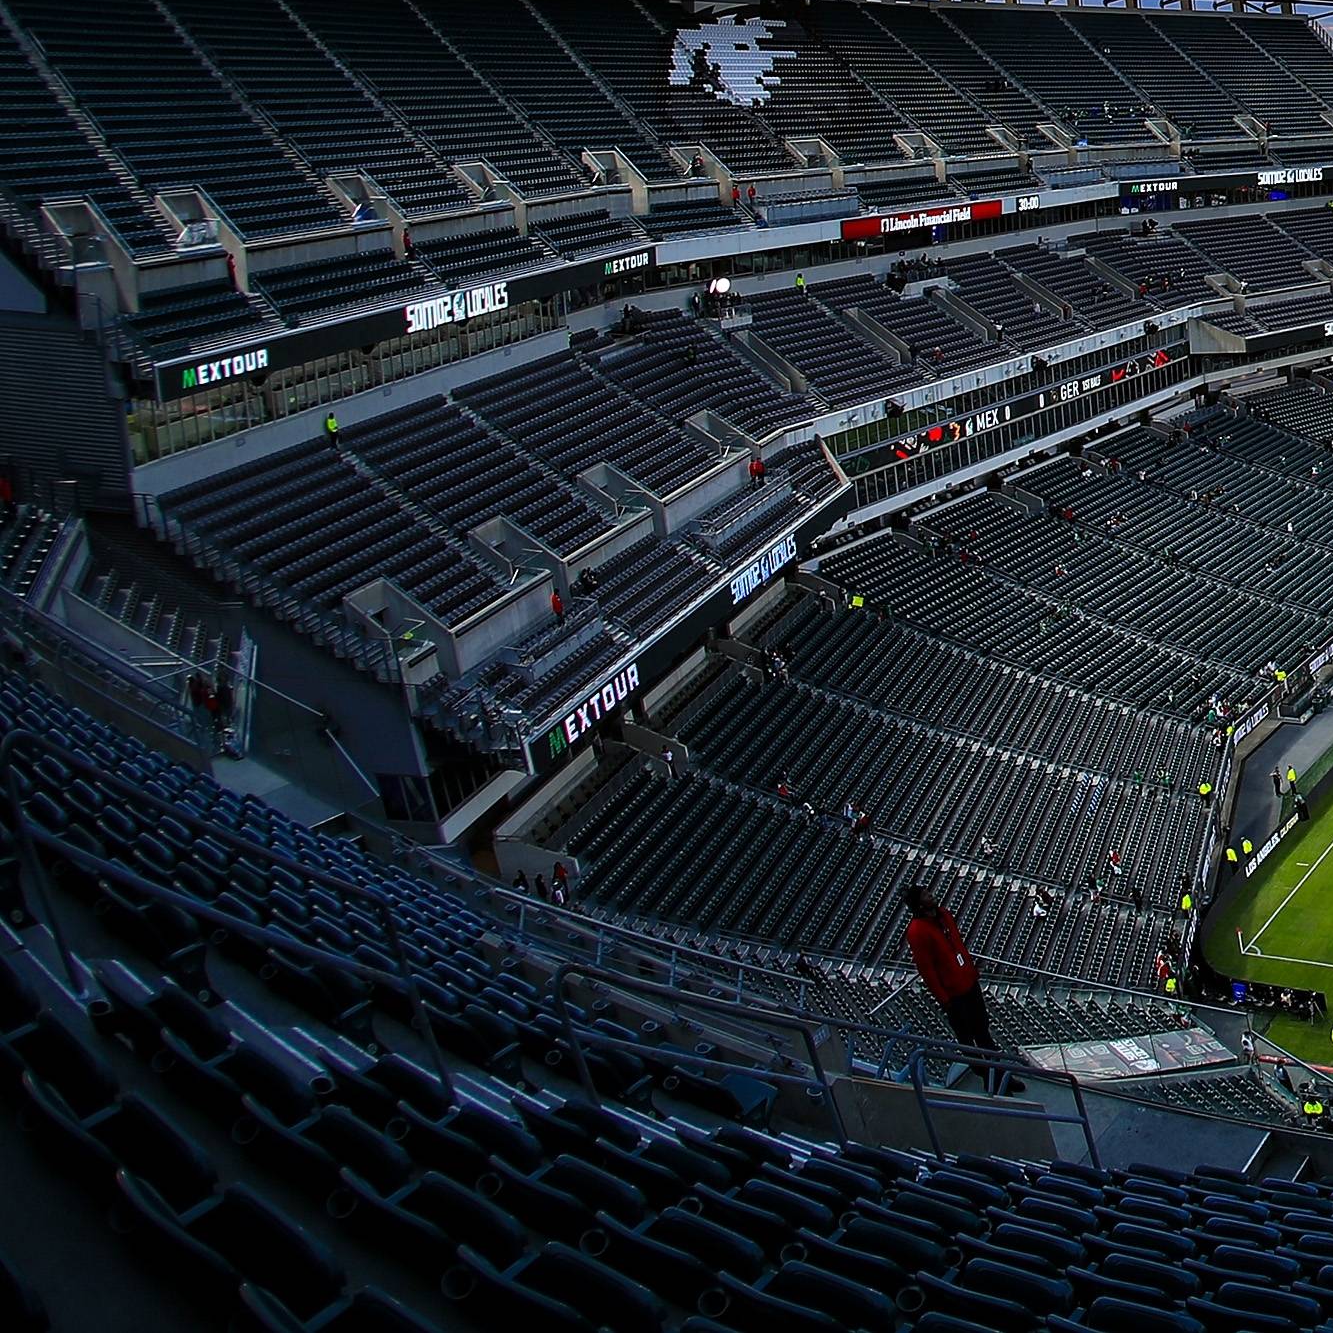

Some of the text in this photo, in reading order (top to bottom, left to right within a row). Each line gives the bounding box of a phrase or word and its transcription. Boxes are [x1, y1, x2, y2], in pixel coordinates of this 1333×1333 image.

[1131, 181, 1178, 194] MEXTOUR
[1018, 196, 1039, 211] 30:00
[890, 207, 971, 232] Lincoln Financial Field
[604, 252, 649, 276] MEXTOUR
[181, 348, 268, 389] MEXTOUR
[1060, 381, 1080, 400] GER
[976, 408, 999, 431] MEX
[549, 663, 640, 759] MEXTOUR
